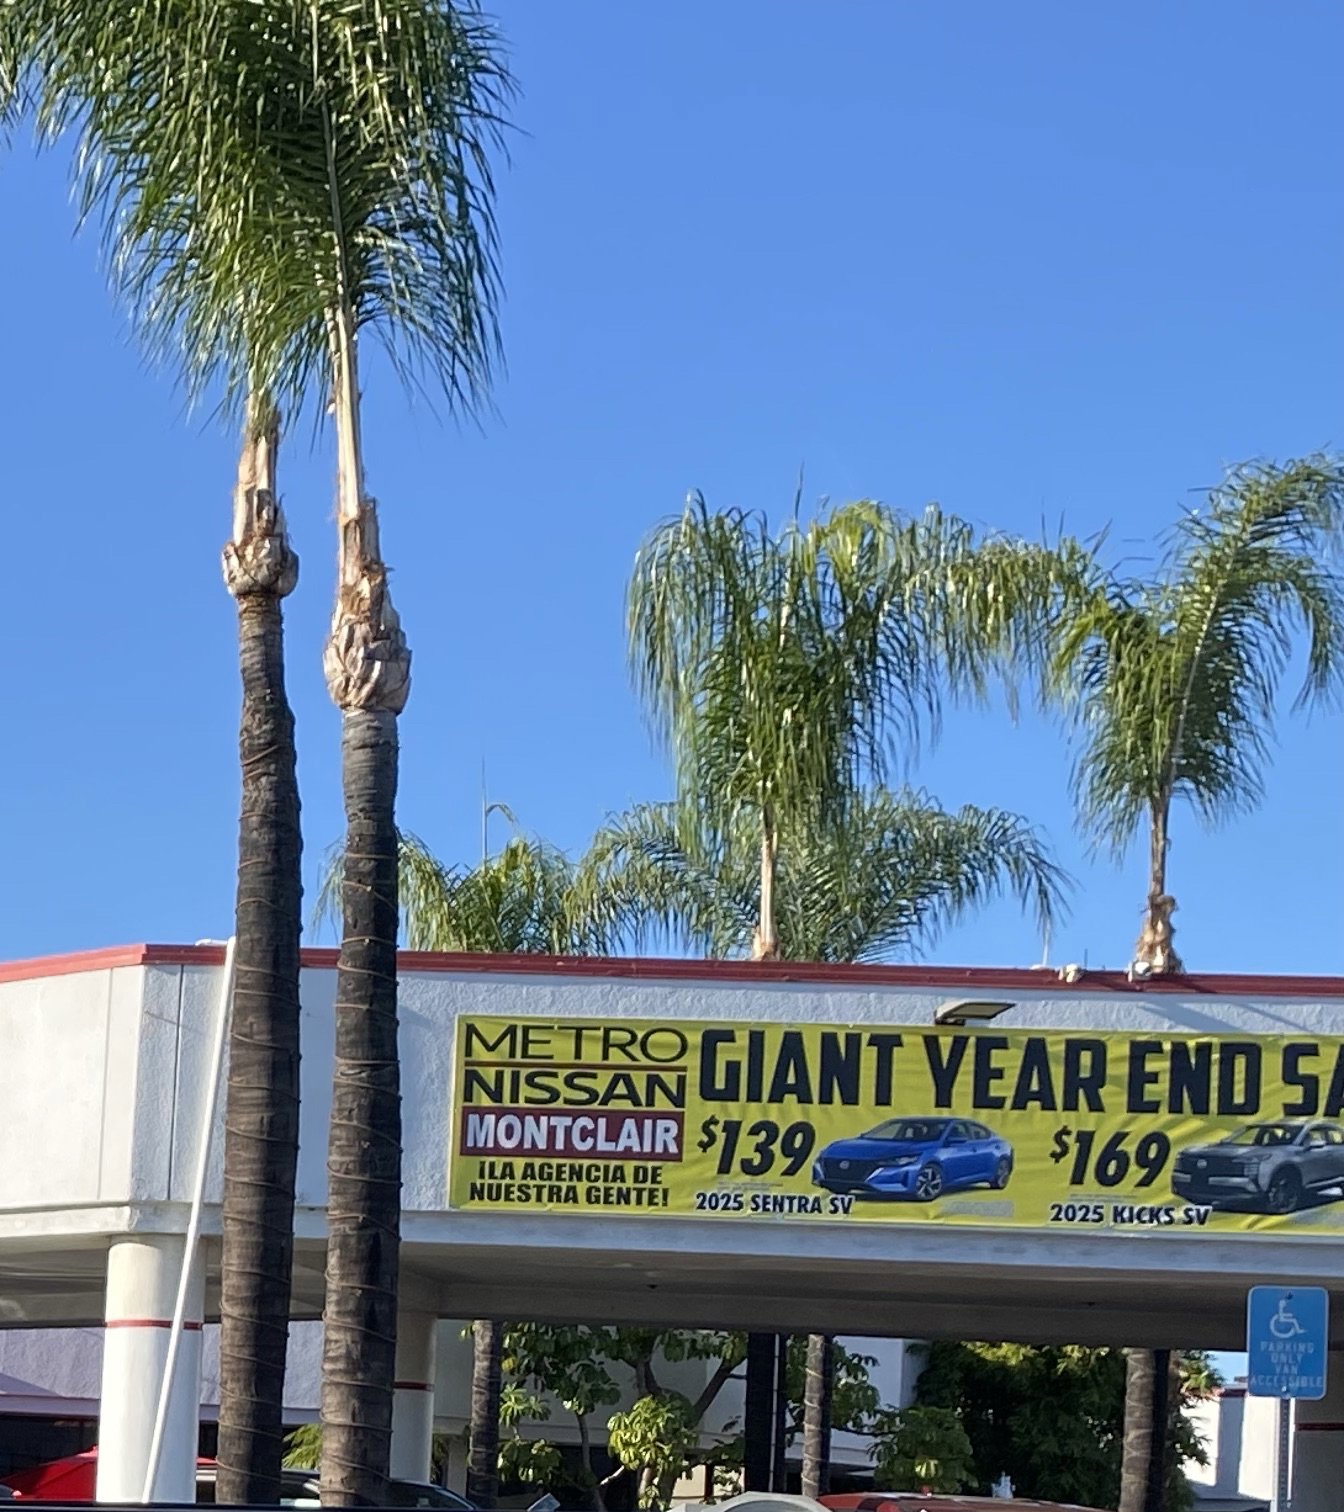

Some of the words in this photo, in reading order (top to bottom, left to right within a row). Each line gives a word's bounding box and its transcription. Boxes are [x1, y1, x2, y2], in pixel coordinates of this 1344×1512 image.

[465, 1023, 689, 1063] METRO
[699, 1028, 903, 1106] GIANT
[922, 1034, 1107, 1113] YEAR
[1127, 1039, 1263, 1116] END
[463, 1069, 686, 1109] NISSAN
[466, 1113, 679, 1154] MONTCLAIR
[697, 1115, 816, 1177] $139
[1049, 1125, 1171, 1188] $169
[521, 1162, 626, 1184] AGENCIA
[633, 1165, 662, 1185] DE
[470, 1182, 579, 1205] NUESTRA
[585, 1186, 669, 1207] GENTE!
[695, 1192, 744, 1212] 2025
[750, 1193, 822, 1214] SENTRA
[829, 1196, 854, 1215] SV
[1050, 1204, 1105, 1223] 2025
[1112, 1205, 1175, 1226] KICKS
[1182, 1206, 1211, 1226] SV
[1260, 1341, 1315, 1354] PARKING
[1270, 1352, 1304, 1364] ONLY
[1275, 1363, 1299, 1375] VAN
